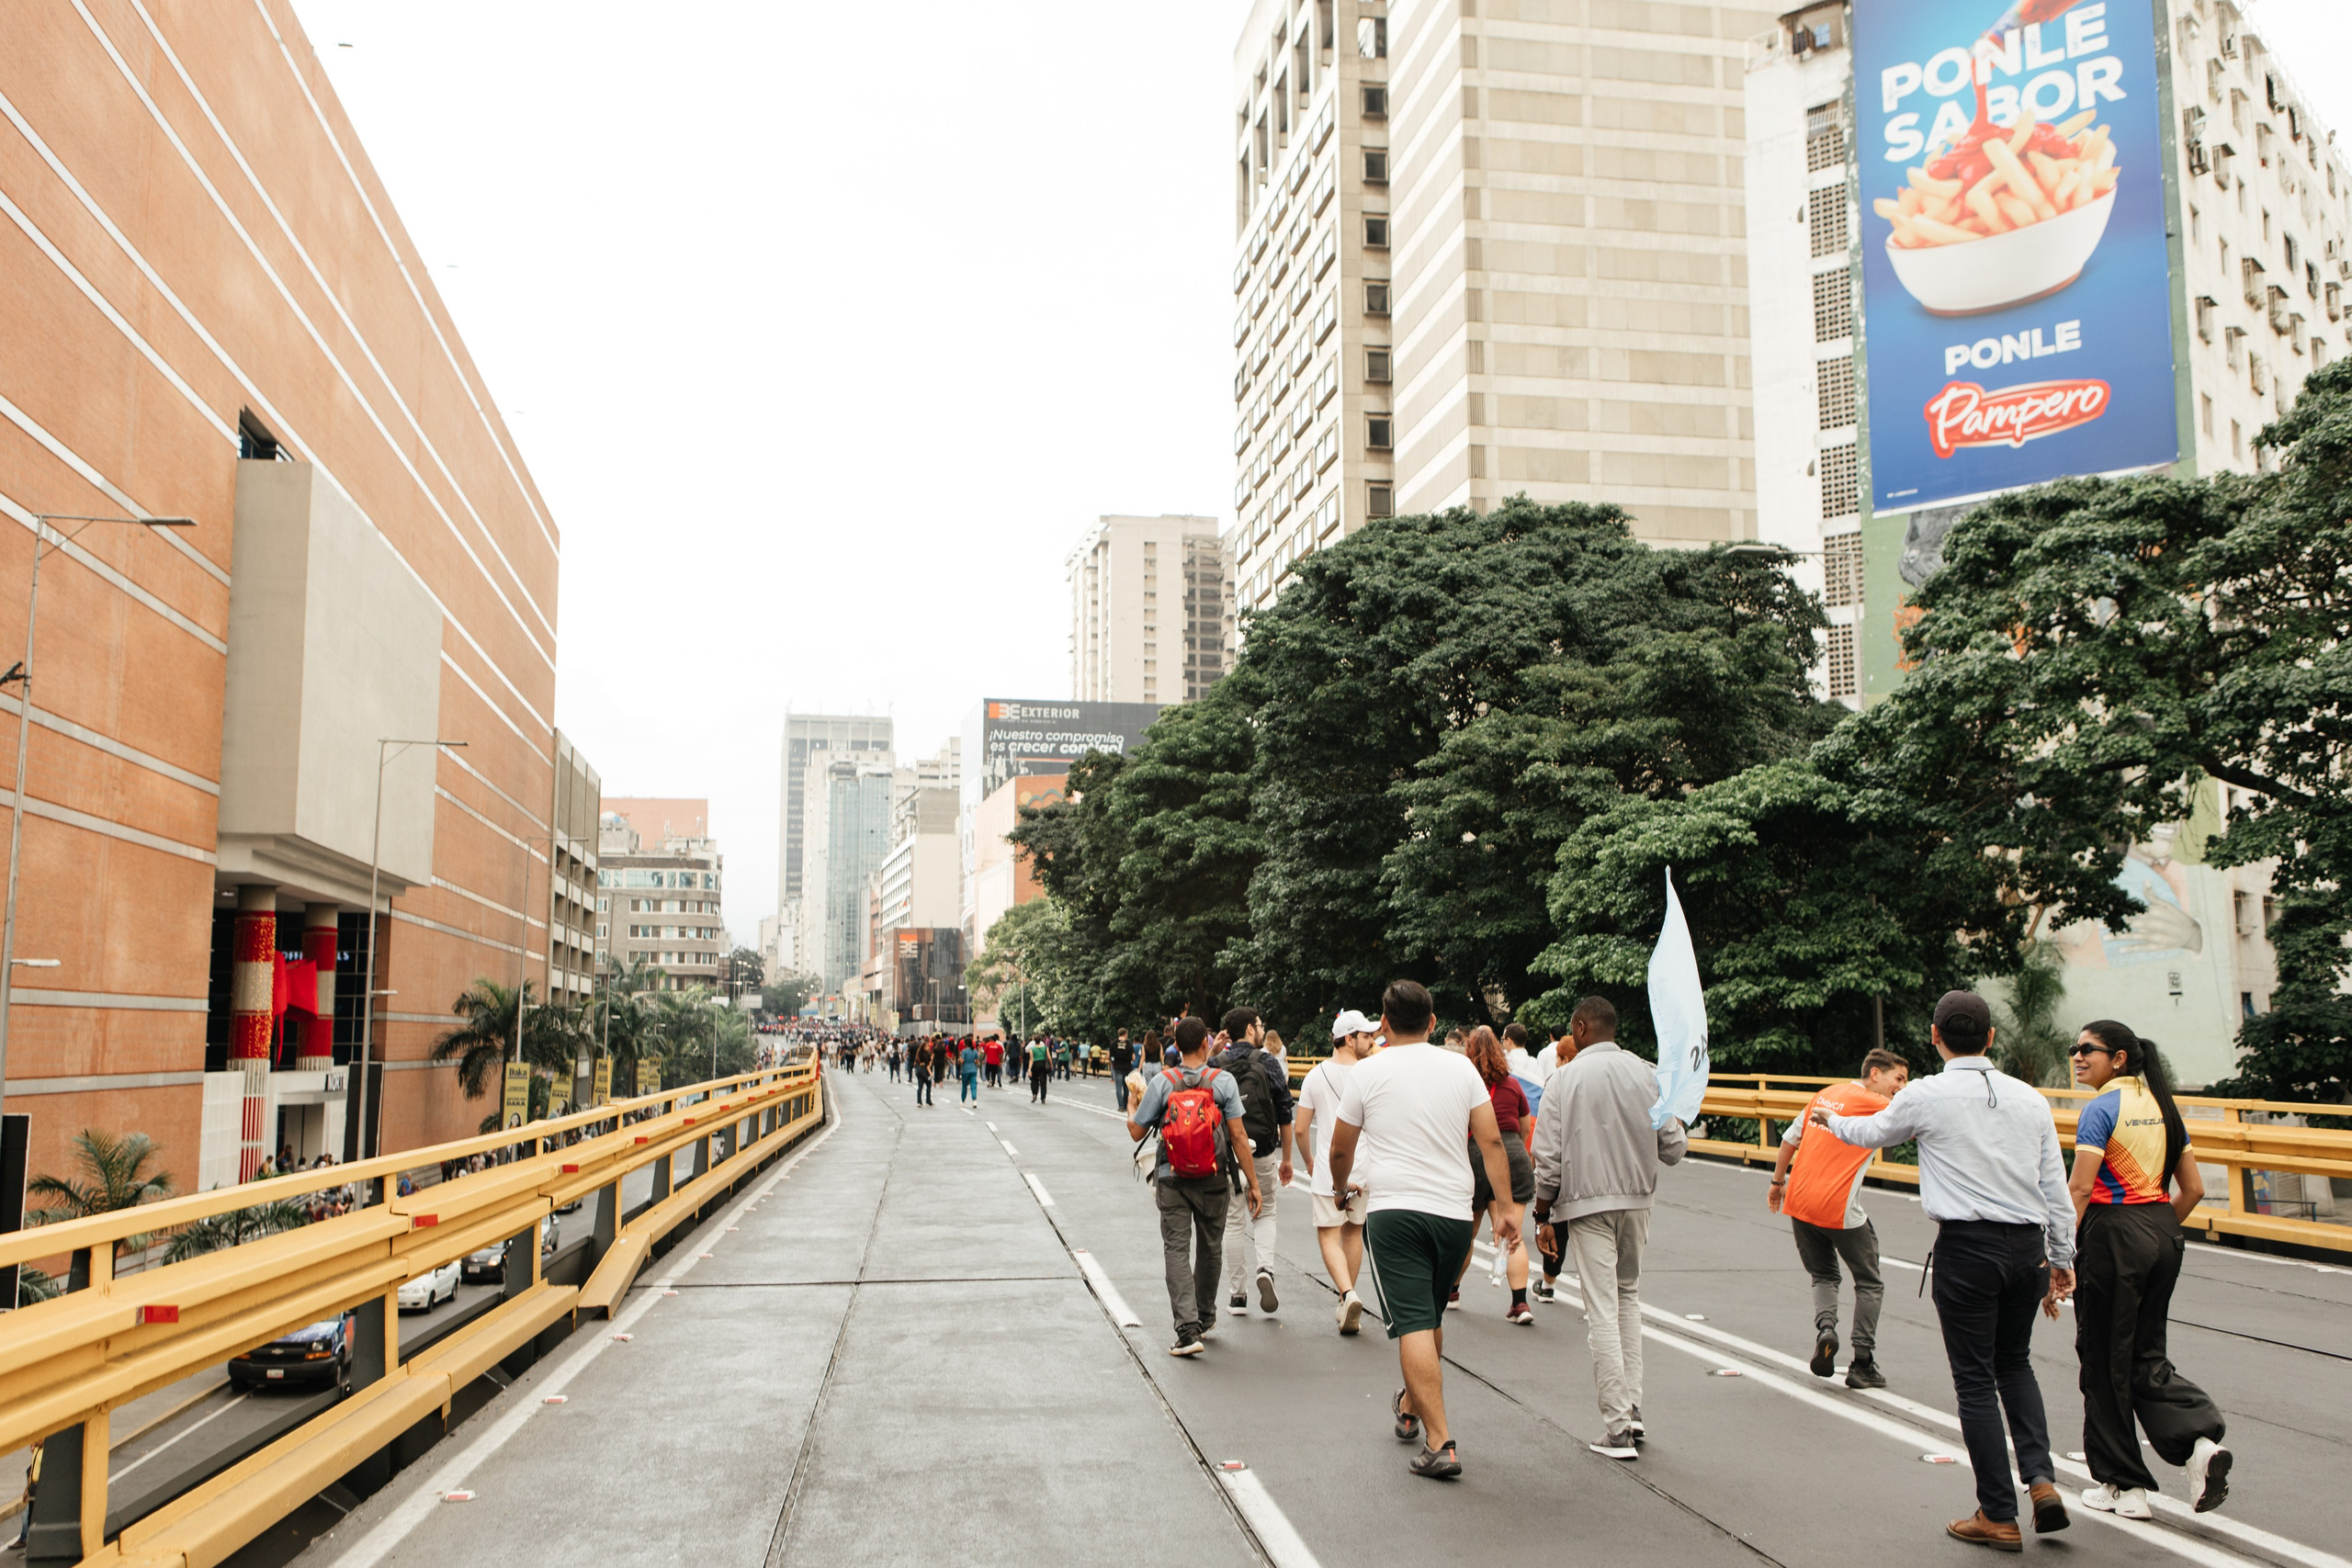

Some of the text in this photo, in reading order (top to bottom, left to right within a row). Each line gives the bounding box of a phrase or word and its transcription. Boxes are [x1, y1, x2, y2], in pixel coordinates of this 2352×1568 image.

[1881, 2, 2110, 114] PONLE
[1883, 55, 2128, 164] SABOR
[1944, 319, 2083, 377] PONLE
[1929, 381, 2105, 449] Pampero
[1021, 706, 1080, 719] EXTERIOR
[989, 728, 1125, 744] ¡Nuestro compromiso
[989, 741, 1006, 752] es
[1008, 741, 1056, 753] crecer
[508, 1067, 527, 1077] Daka
[1816, 1096, 1845, 1111] СМЫСЛ
[2124, 1118, 2165, 1127] VENEZUE
